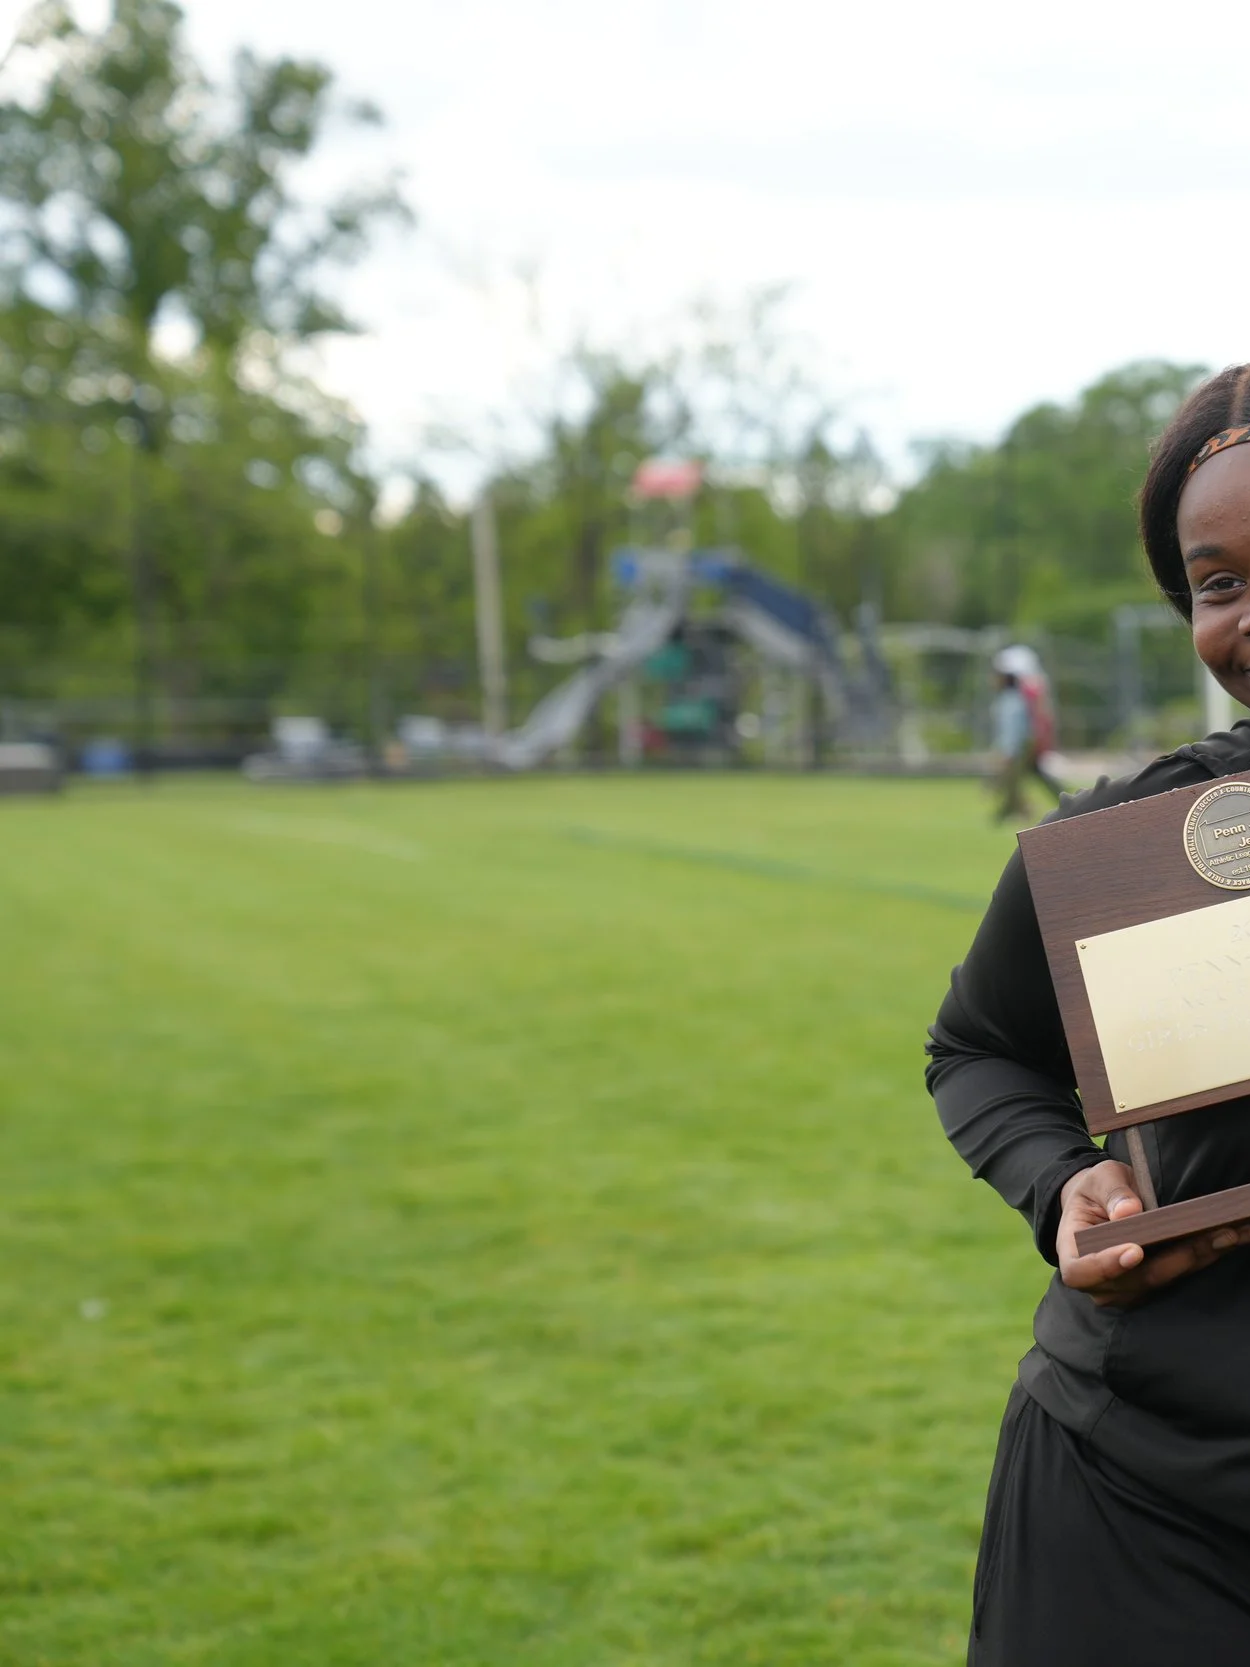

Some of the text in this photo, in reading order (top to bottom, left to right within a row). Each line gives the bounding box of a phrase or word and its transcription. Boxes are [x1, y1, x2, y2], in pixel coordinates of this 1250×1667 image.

[1197, 791, 1219, 812] SOCCER
[1187, 811, 1200, 834] TENNIS
[1213, 823, 1247, 840] Penn
[1187, 836, 1207, 874] VOLLEYBALL
[1209, 855, 1235, 867] Athletic
[1207, 871, 1224, 885] FIELD
